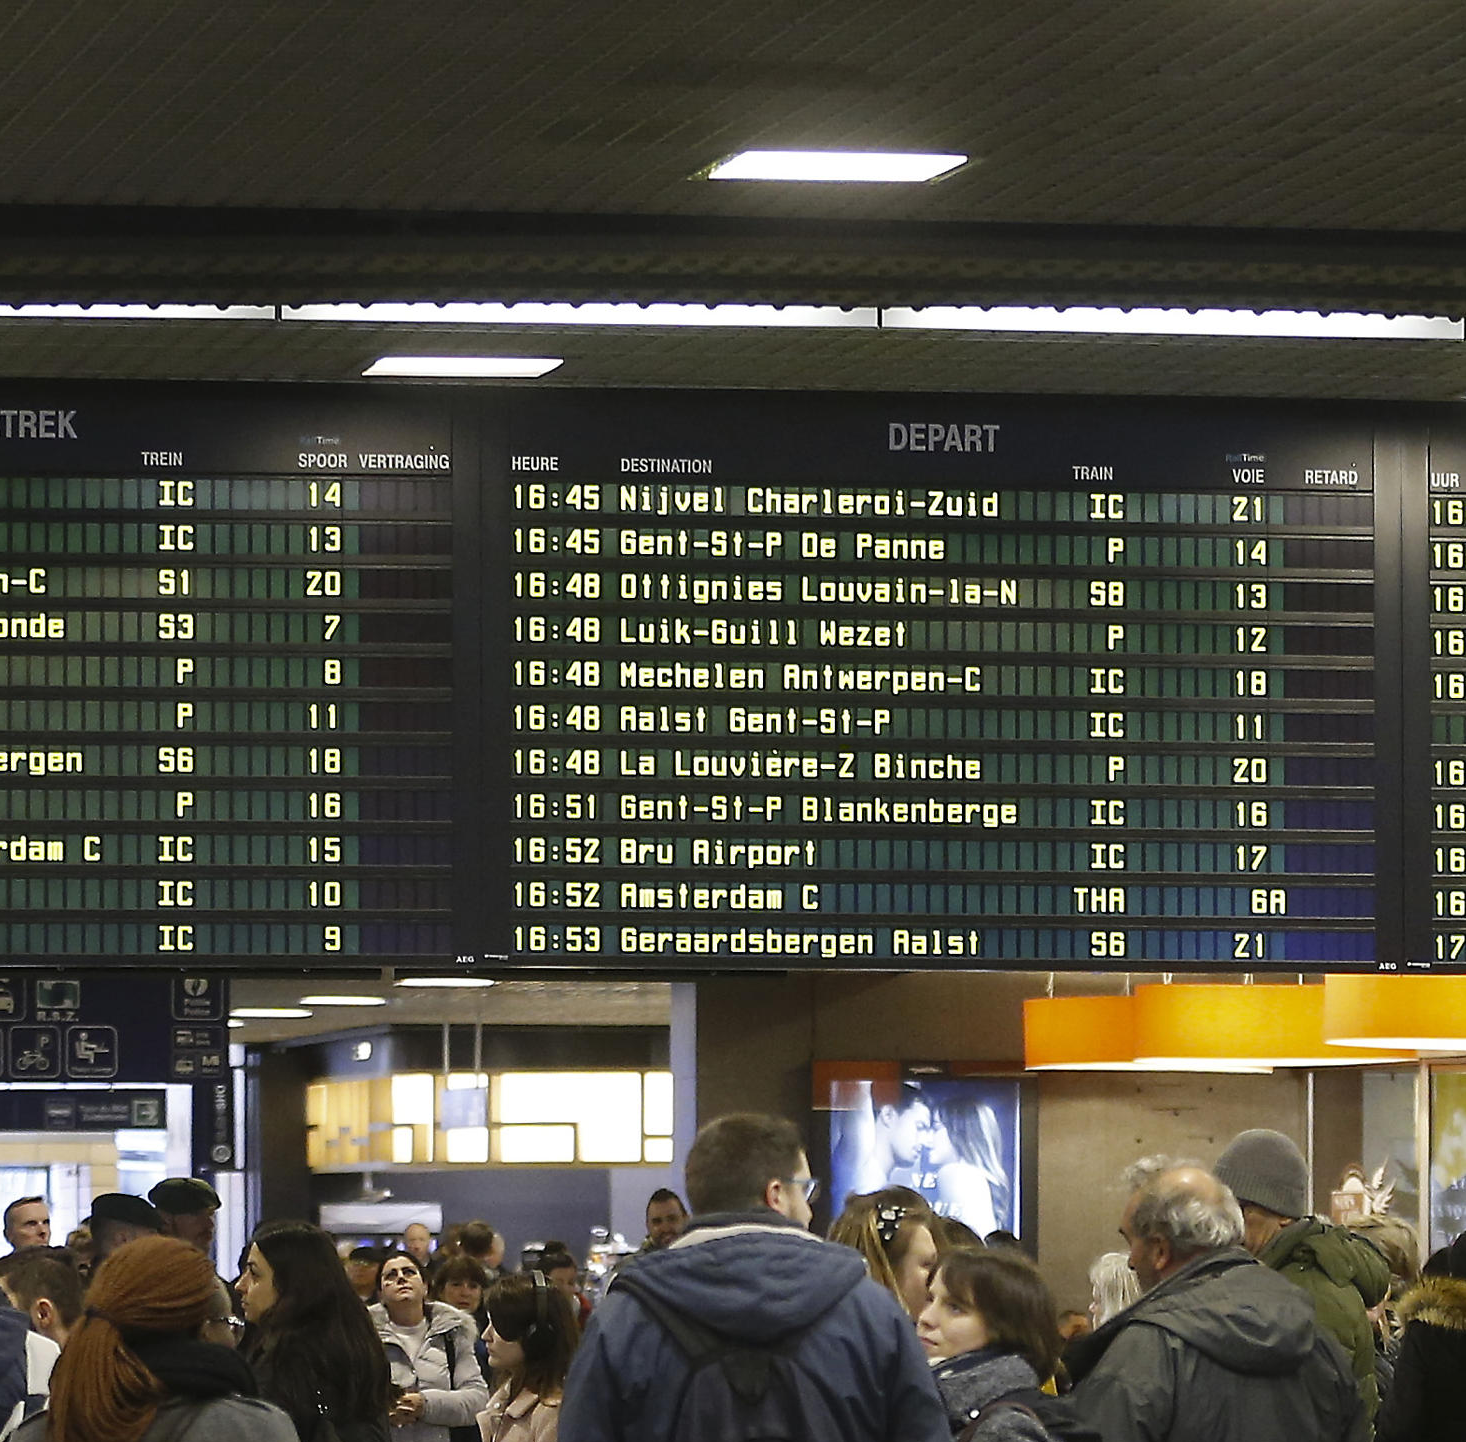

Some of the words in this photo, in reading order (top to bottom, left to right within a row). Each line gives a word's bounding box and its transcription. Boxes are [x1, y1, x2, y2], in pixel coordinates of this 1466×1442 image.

[888, 422, 1000, 453] DEPART
[141, 451, 183, 466] TREIN
[298, 453, 348, 468] SPOOR
[358, 453, 450, 469] VERTRAGING
[511, 455, 559, 471] HEURE
[620, 458, 712, 474] DESTINATION
[1072, 465, 1113, 481] TRAIN
[1232, 468, 1265, 484] VOIE
[1305, 469, 1358, 485] RETARD
[159, 480, 194, 506] IC
[309, 481, 341, 507] 14
[1430, 472, 1460, 488] UUR
[514, 484, 600, 510] 16:45
[620, 485, 724, 515] Nijvel
[747, 487, 998, 517] Charleroi-Zuid
[1090, 493, 1124, 519] IC
[1232, 496, 1262, 522] 21
[514, 572, 600, 598] 16:48
[620, 573, 782, 604] Ottignies
[802, 576, 1017, 605] Louvain-la-N
[1090, 581, 1124, 606] S8
[1236, 583, 1267, 609] 13
[177, 658, 194, 684] P
[324, 659, 341, 685] 8
[514, 749, 600, 775] 16:48
[620, 750, 655, 775] La
[675, 749, 855, 778] Louvière-Z
[874, 753, 981, 779] Binche
[1108, 756, 1124, 782] P
[1233, 758, 1267, 783] 20
[177, 791, 193, 817] P
[309, 792, 341, 818] 16
[84, 836, 101, 861] C
[158, 836, 193, 862] IC
[309, 837, 341, 862] 15
[514, 881, 600, 908] 16:52
[621, 883, 782, 910] Amsterdam
[802, 884, 819, 910] C
[1073, 887, 1125, 913] THA
